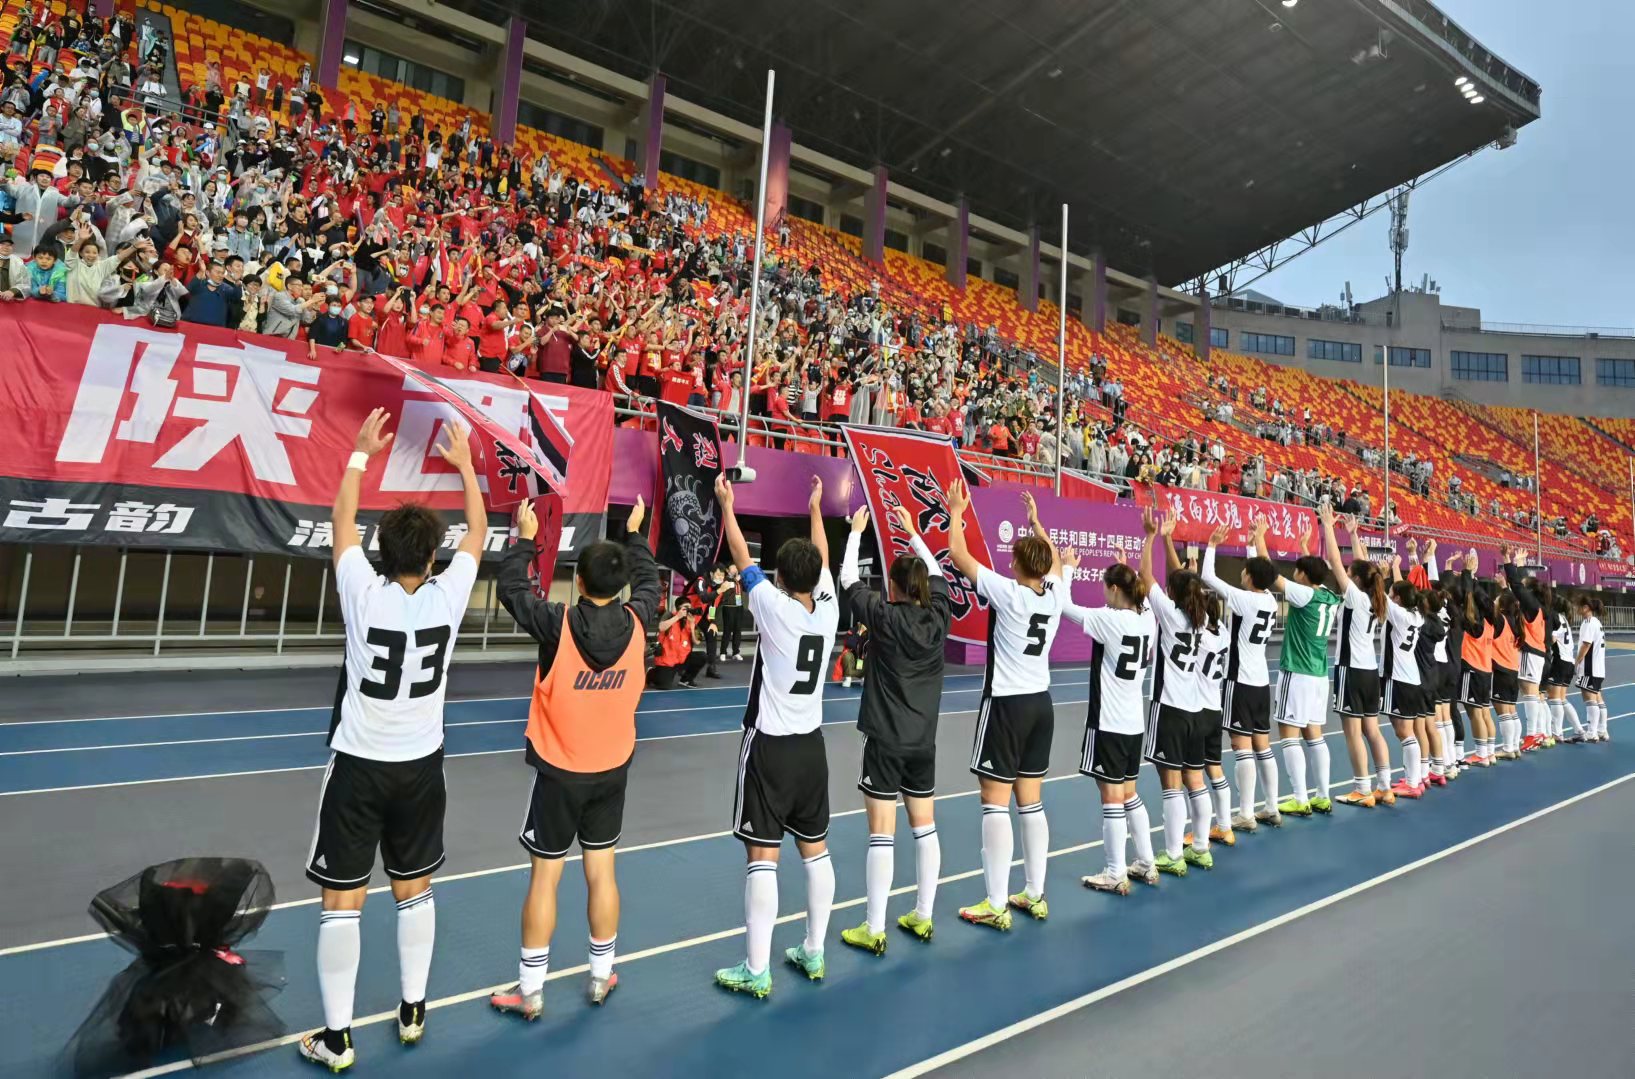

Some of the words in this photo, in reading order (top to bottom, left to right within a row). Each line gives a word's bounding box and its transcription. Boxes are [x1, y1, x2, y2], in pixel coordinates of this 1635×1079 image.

[2, 497, 196, 534] 古韵
[1018, 525, 1146, 551] 中民共和国第十四届运动
[1022, 613, 1052, 656] 5
[359, 625, 451, 700] 33
[789, 635, 825, 695] 9
